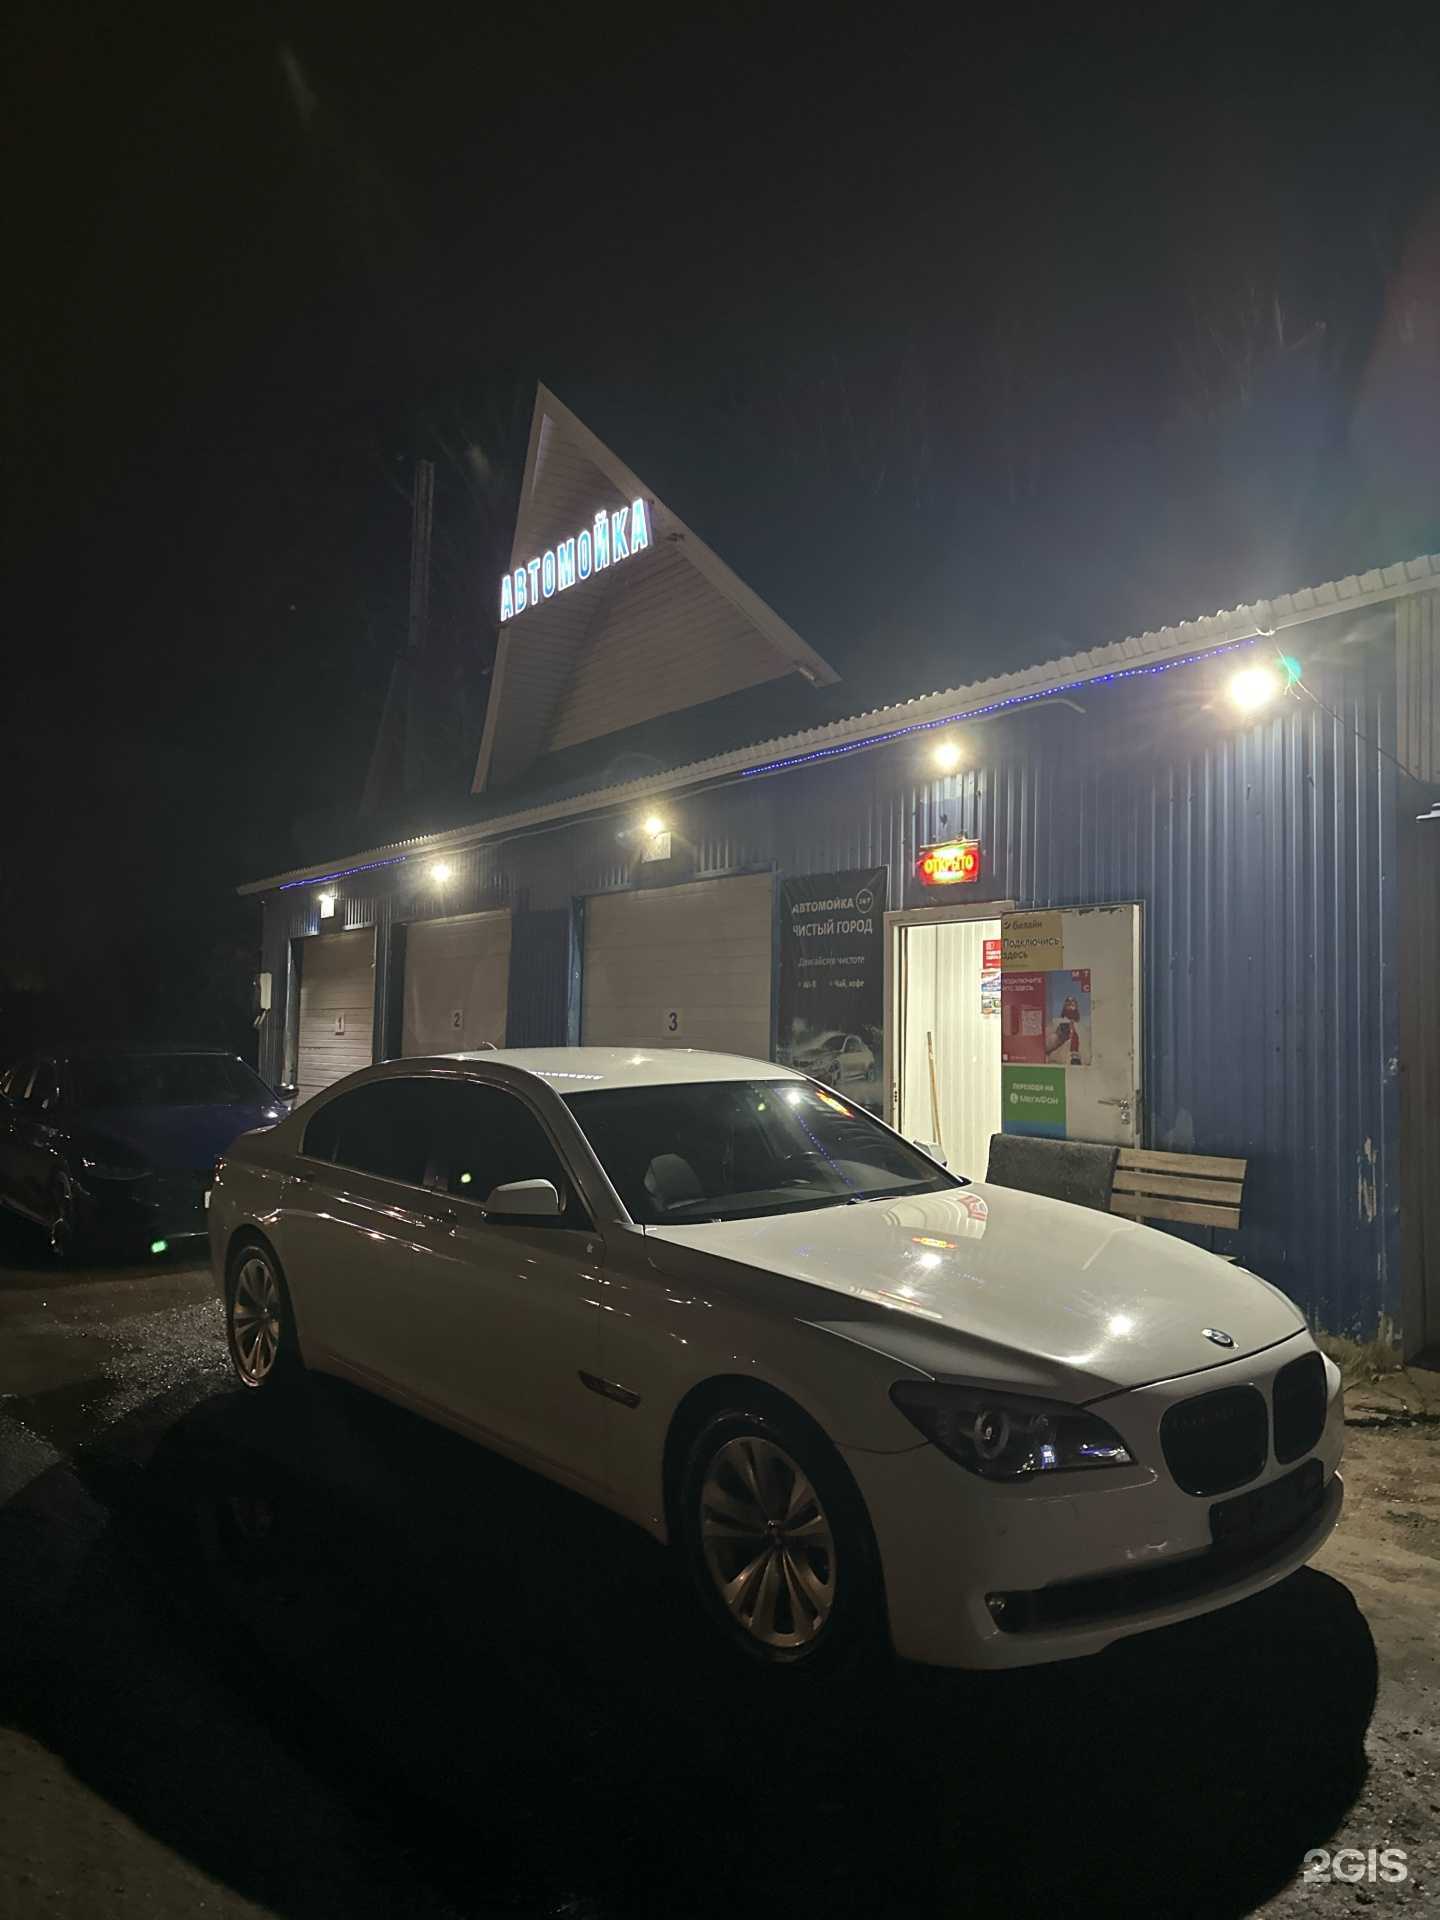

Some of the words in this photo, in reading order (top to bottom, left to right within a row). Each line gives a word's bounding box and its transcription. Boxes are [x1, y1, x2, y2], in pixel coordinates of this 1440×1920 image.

[500, 497, 649, 623] АВТОМОЙКА
[792, 897, 855, 914] АВТОМОЙКА
[792, 919, 834, 937] ЧИСТЫЙ
[836, 918, 873, 935] ГОРОД
[1003, 938, 1060, 949] Подключись
[453, 1012, 461, 1028] 2
[668, 1012, 678, 1031] 3
